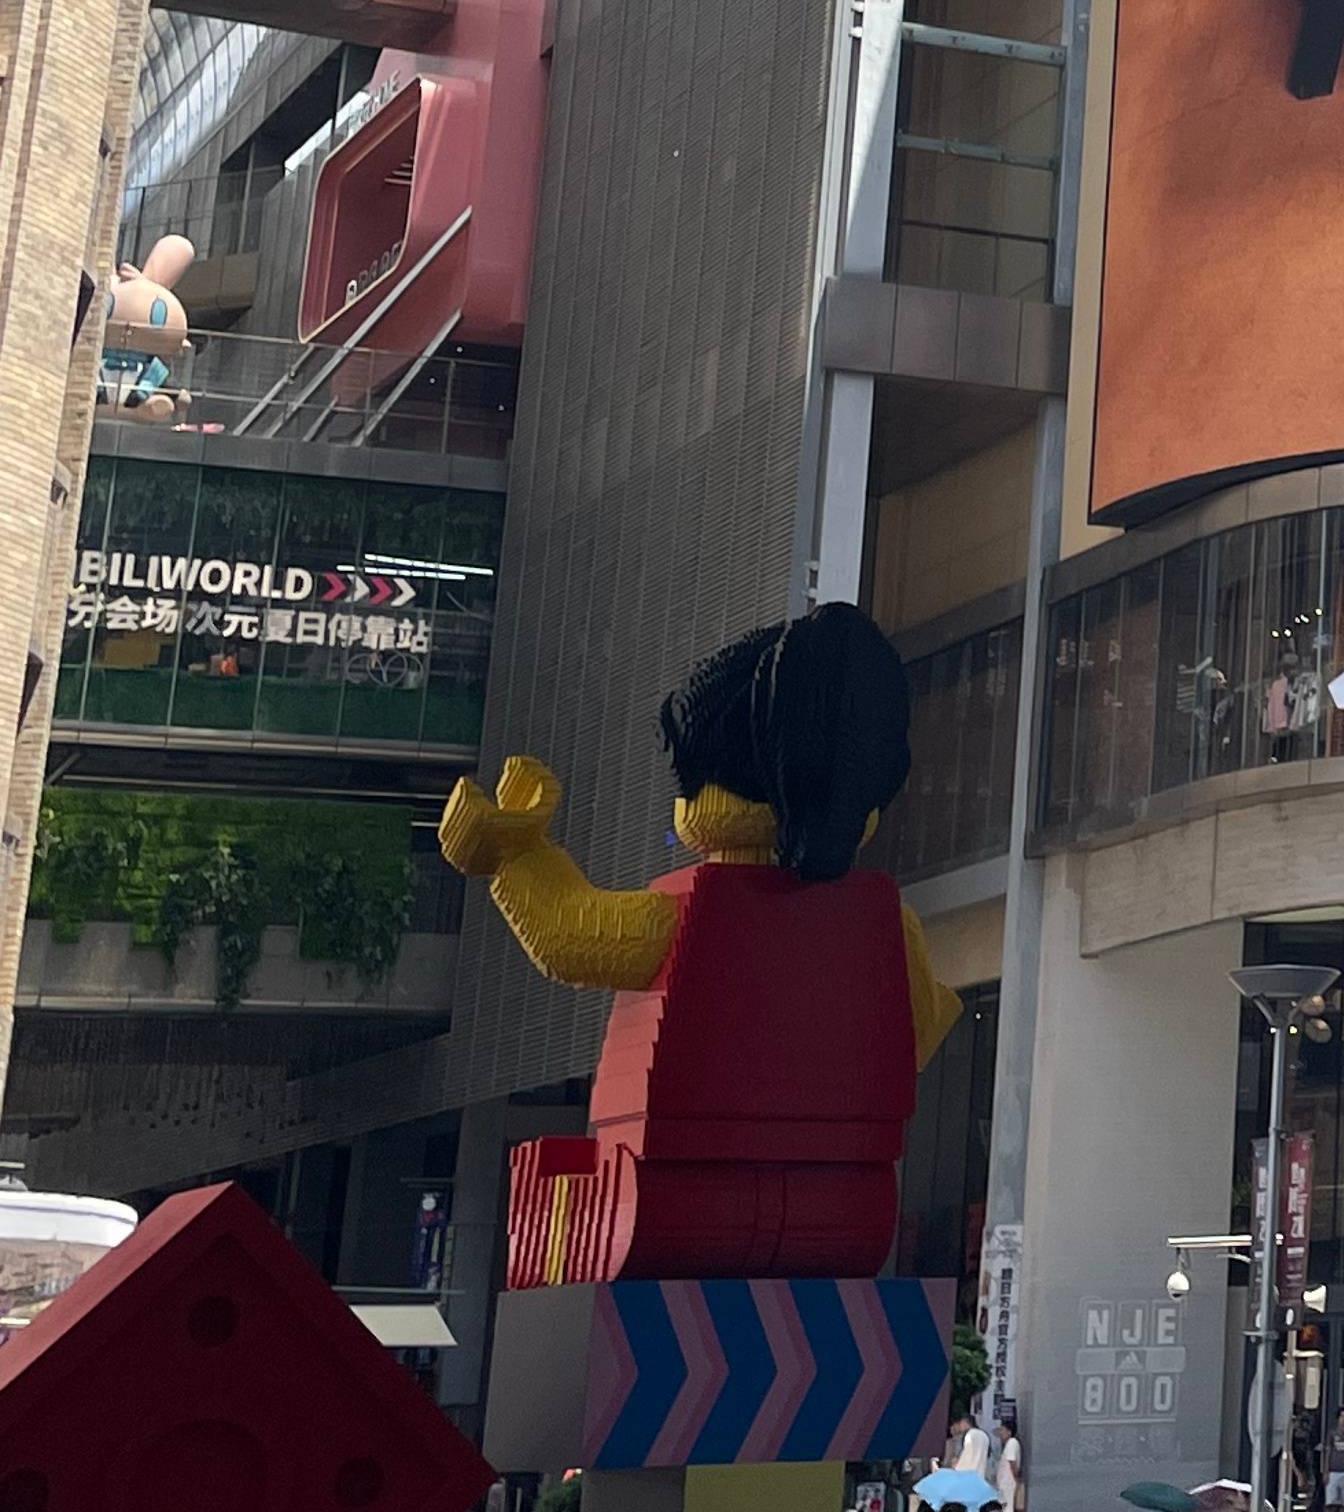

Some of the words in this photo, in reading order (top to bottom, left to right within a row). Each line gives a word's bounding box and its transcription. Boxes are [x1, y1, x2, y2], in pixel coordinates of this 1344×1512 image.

[78, 550, 314, 601] BILIWORLD
[186, 601, 433, 654] 次元夏日停靠站
[1085, 1308, 1176, 1345] NJE
[1083, 1375, 1174, 1413] 800
